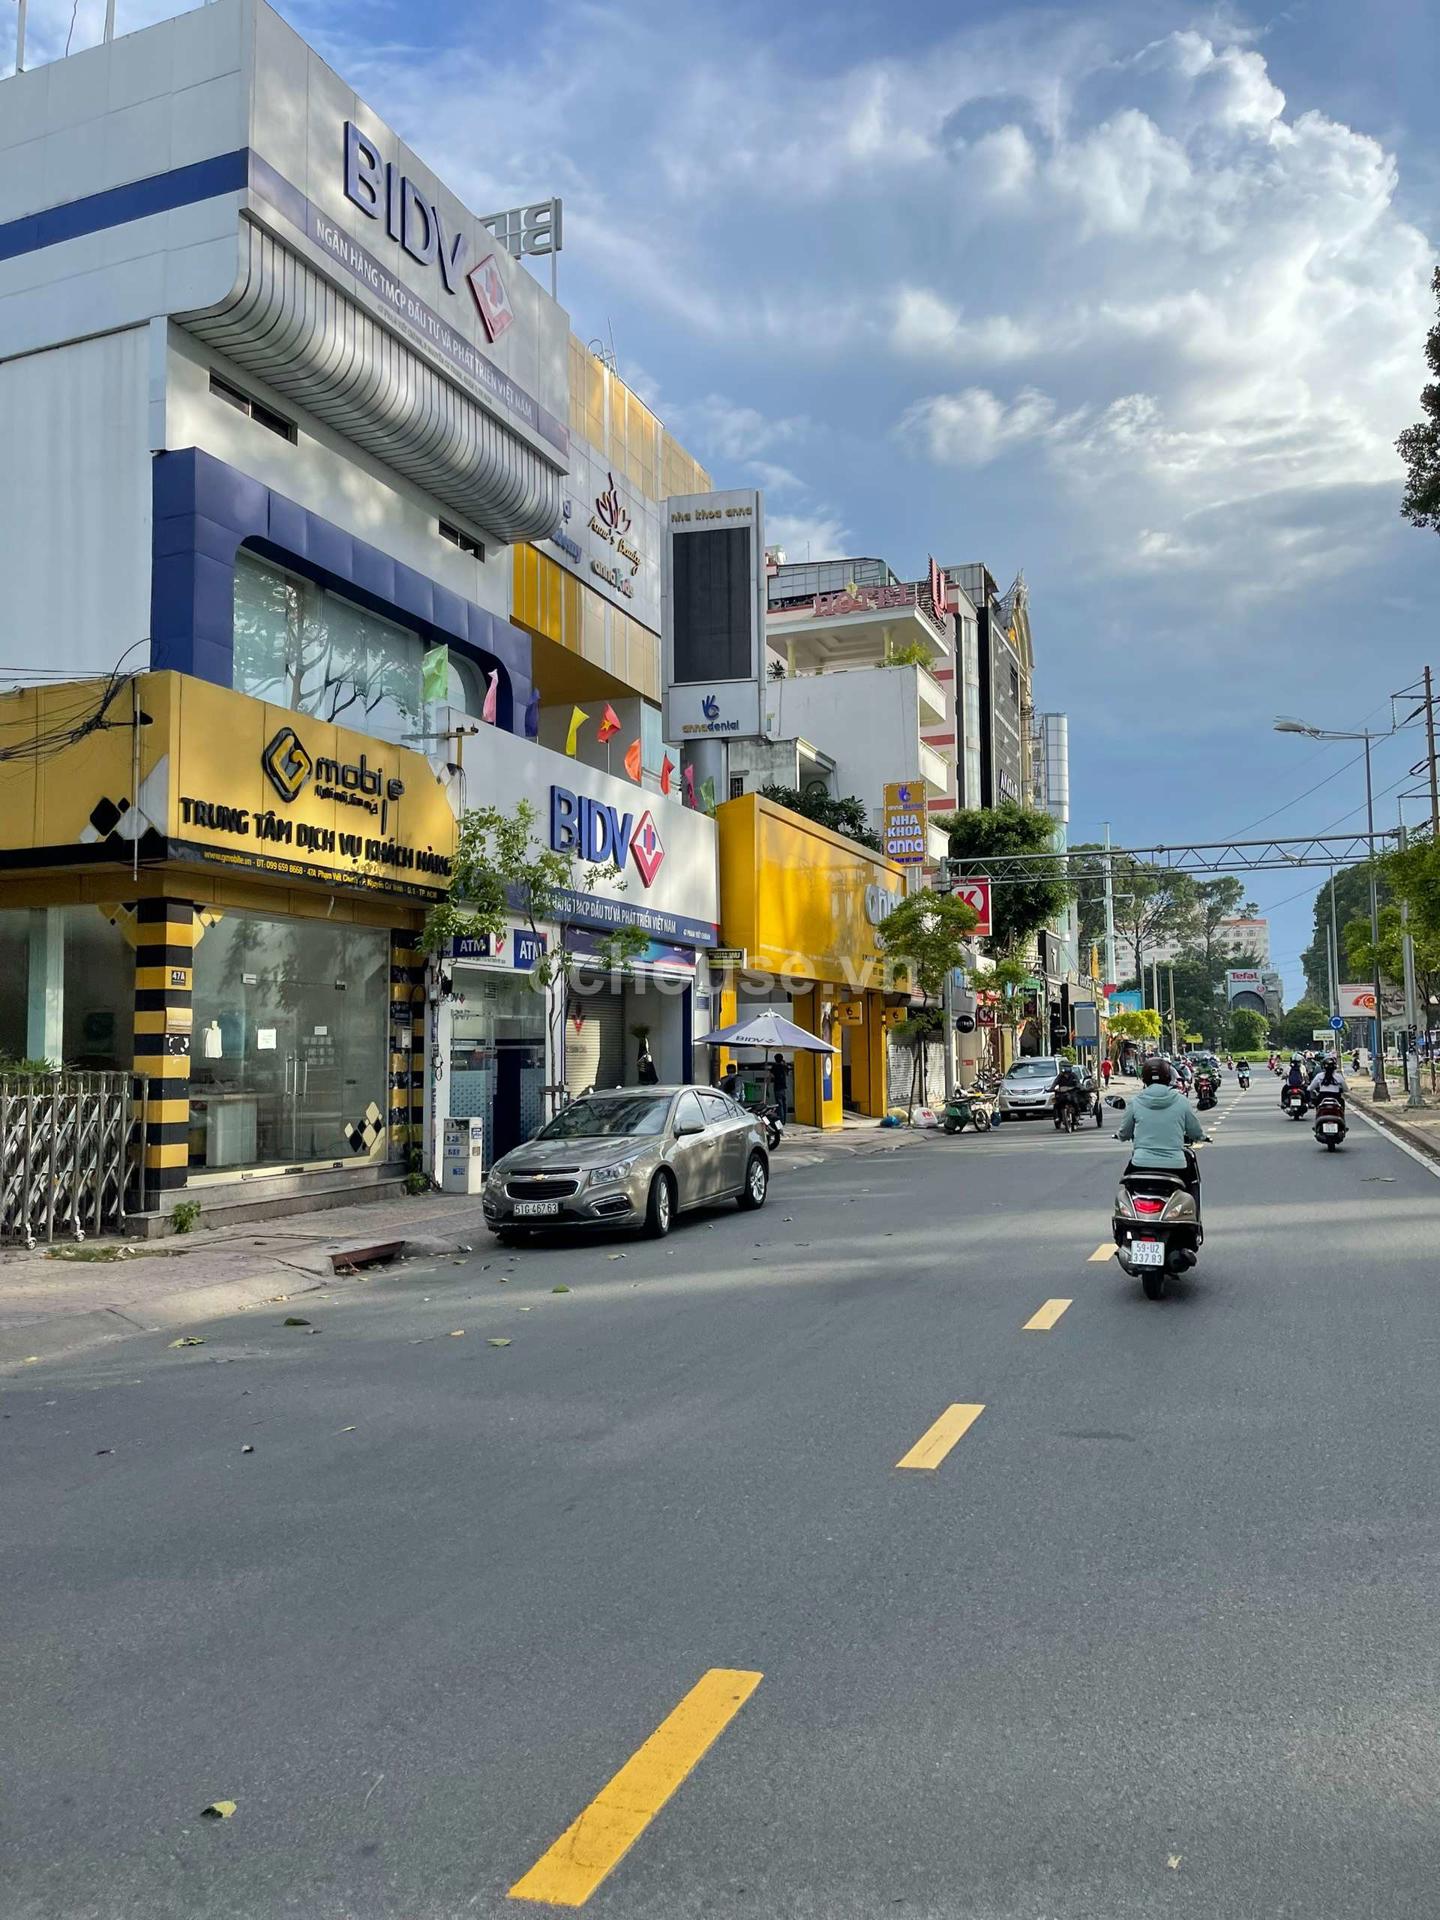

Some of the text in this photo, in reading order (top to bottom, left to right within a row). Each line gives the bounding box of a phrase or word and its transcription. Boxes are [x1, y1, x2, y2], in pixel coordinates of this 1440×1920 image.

[344, 121, 468, 294] BIDV
[316, 218, 348, 261] NGÂN
[350, 247, 378, 288] HÀNG
[379, 274, 407, 310] TMCP
[427, 316, 440, 341] TƯ
[441, 328, 453, 353] VÀ
[453, 340, 474, 371] PHÁT
[551, 785, 634, 869] BIDV
[891, 815, 919, 826] NHA
[180, 797, 249, 835] TRUNG
[254, 811, 293, 845] TÂM
[296, 821, 335, 855] DỊCH
[338, 833, 363, 864] VỤ
[364, 837, 414, 869] KHÁCH
[888, 826, 922, 838] KHOA
[887, 838, 924, 854] anna
[604, 906, 613, 921] TƯ
[613, 906, 621, 923] VÀ
[621, 907, 638, 925] PHÁT
[652, 916, 664, 934] VIỆT
[664, 920, 677, 934] NAM
[460, 939, 486, 953] ATM
[520, 940, 542, 960] ATM
[172, 972, 185, 980] 47A
[1232, 972, 1259, 980] Tefal
